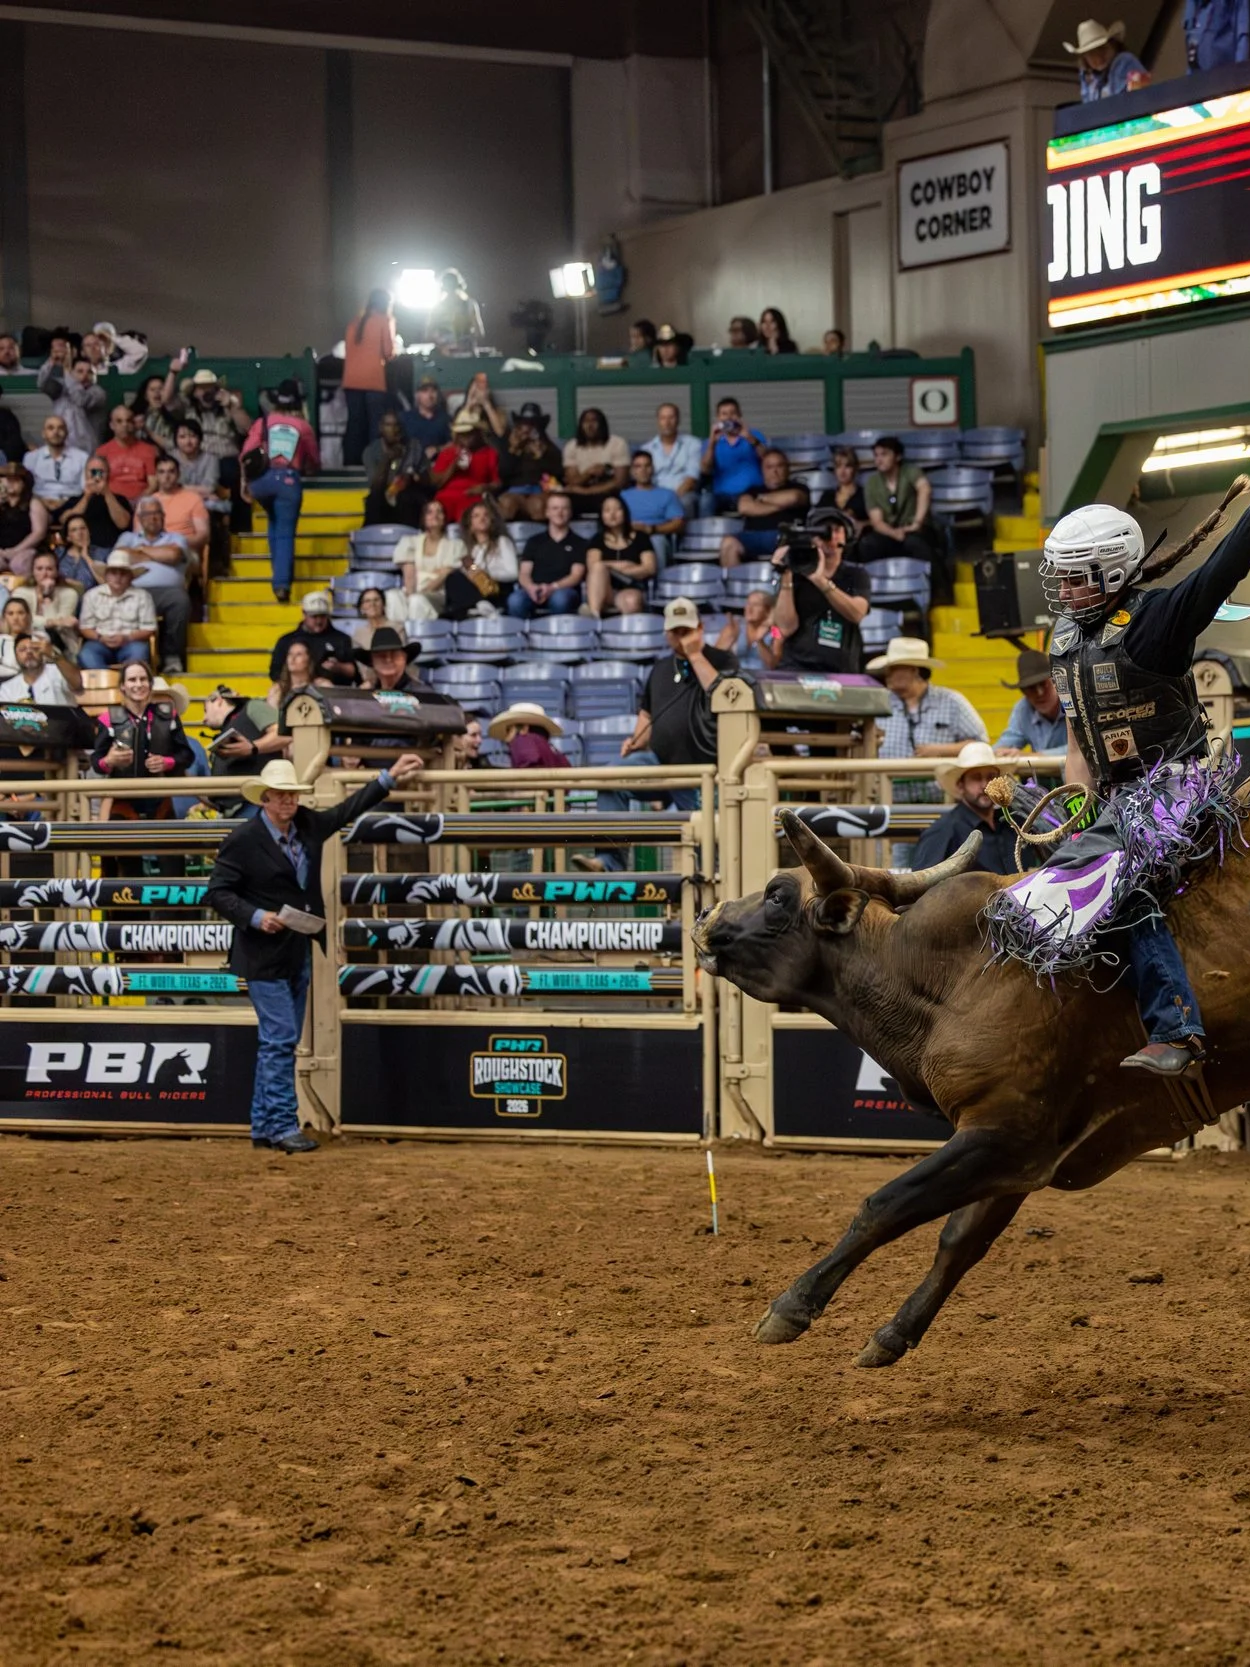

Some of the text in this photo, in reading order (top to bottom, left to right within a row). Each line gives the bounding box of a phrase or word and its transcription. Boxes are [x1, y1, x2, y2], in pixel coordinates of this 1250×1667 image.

[910, 166, 996, 207] COWBOY
[915, 205, 993, 242] CORNER
[920, 388, 949, 414] O
[1104, 729, 1132, 741] ARIAT
[140, 885, 209, 904] PW
[544, 881, 638, 901] PWR
[120, 924, 235, 951] CHAMPIONSHI
[525, 921, 664, 950] CHAMPIONSHIP
[179, 975, 202, 989] TEXAS
[25, 1042, 211, 1084] PBR
[473, 1056, 563, 1088] ROUGHSTOCK
[25, 1089, 206, 1101] PROFESSIONAL BULL RIDERS
[494, 1081, 542, 1095] SHOWCASE
[853, 1100, 916, 1111] PREMI
